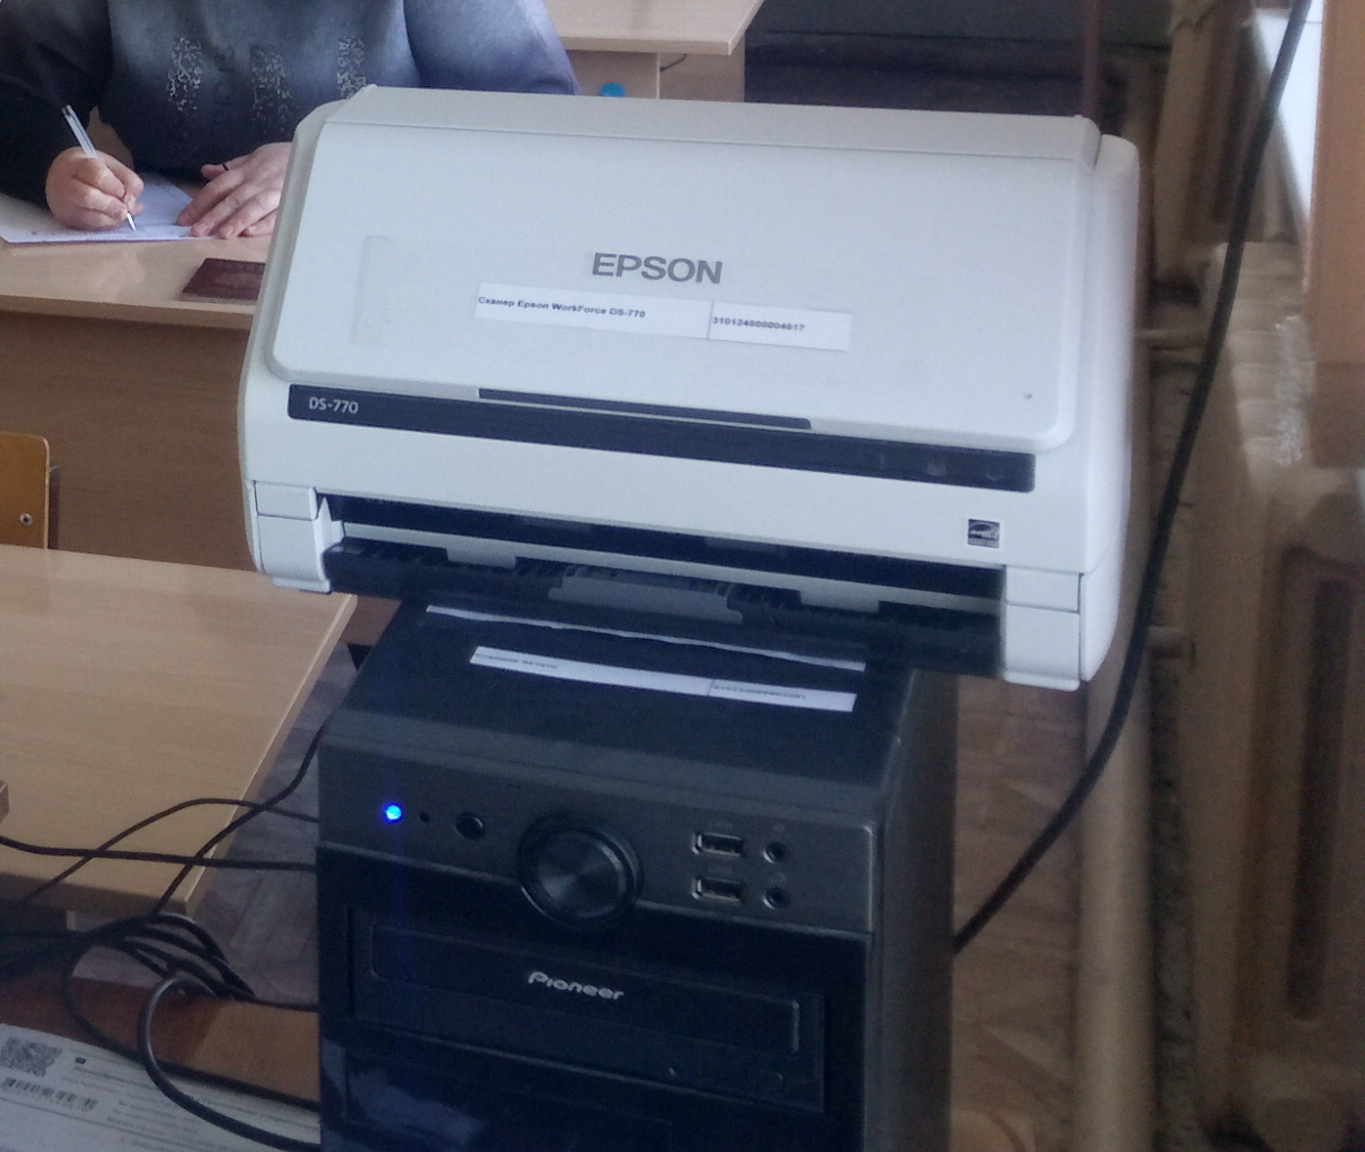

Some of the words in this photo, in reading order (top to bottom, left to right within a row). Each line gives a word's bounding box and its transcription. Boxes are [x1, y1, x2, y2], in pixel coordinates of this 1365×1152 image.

[592, 252, 723, 284] EPSON
[517, 299, 549, 311] Epson
[609, 307, 646, 318] DS-770
[309, 396, 359, 414] DS-770
[528, 971, 625, 1001] Pioneer
